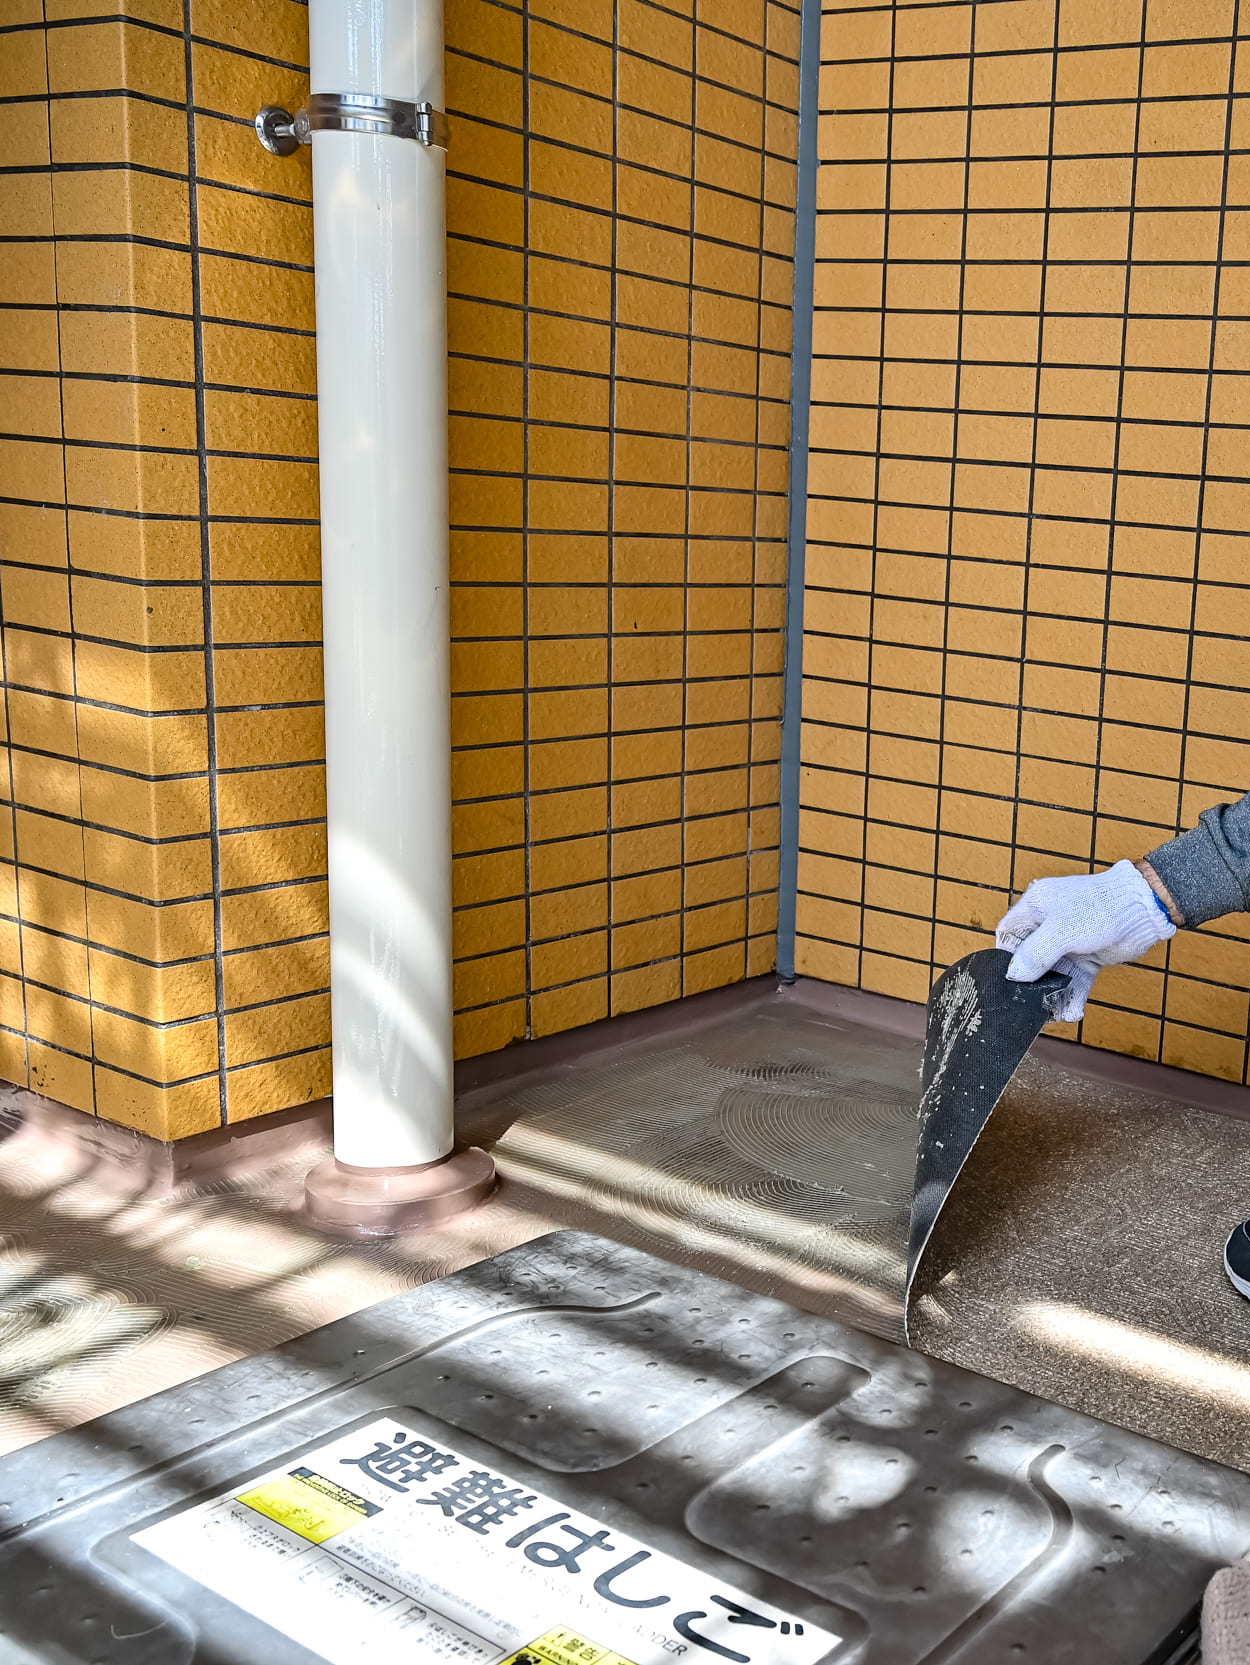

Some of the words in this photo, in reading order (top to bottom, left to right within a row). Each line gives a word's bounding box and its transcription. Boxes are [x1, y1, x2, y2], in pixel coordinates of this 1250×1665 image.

[339, 1431, 804, 1663] 避難はしご
